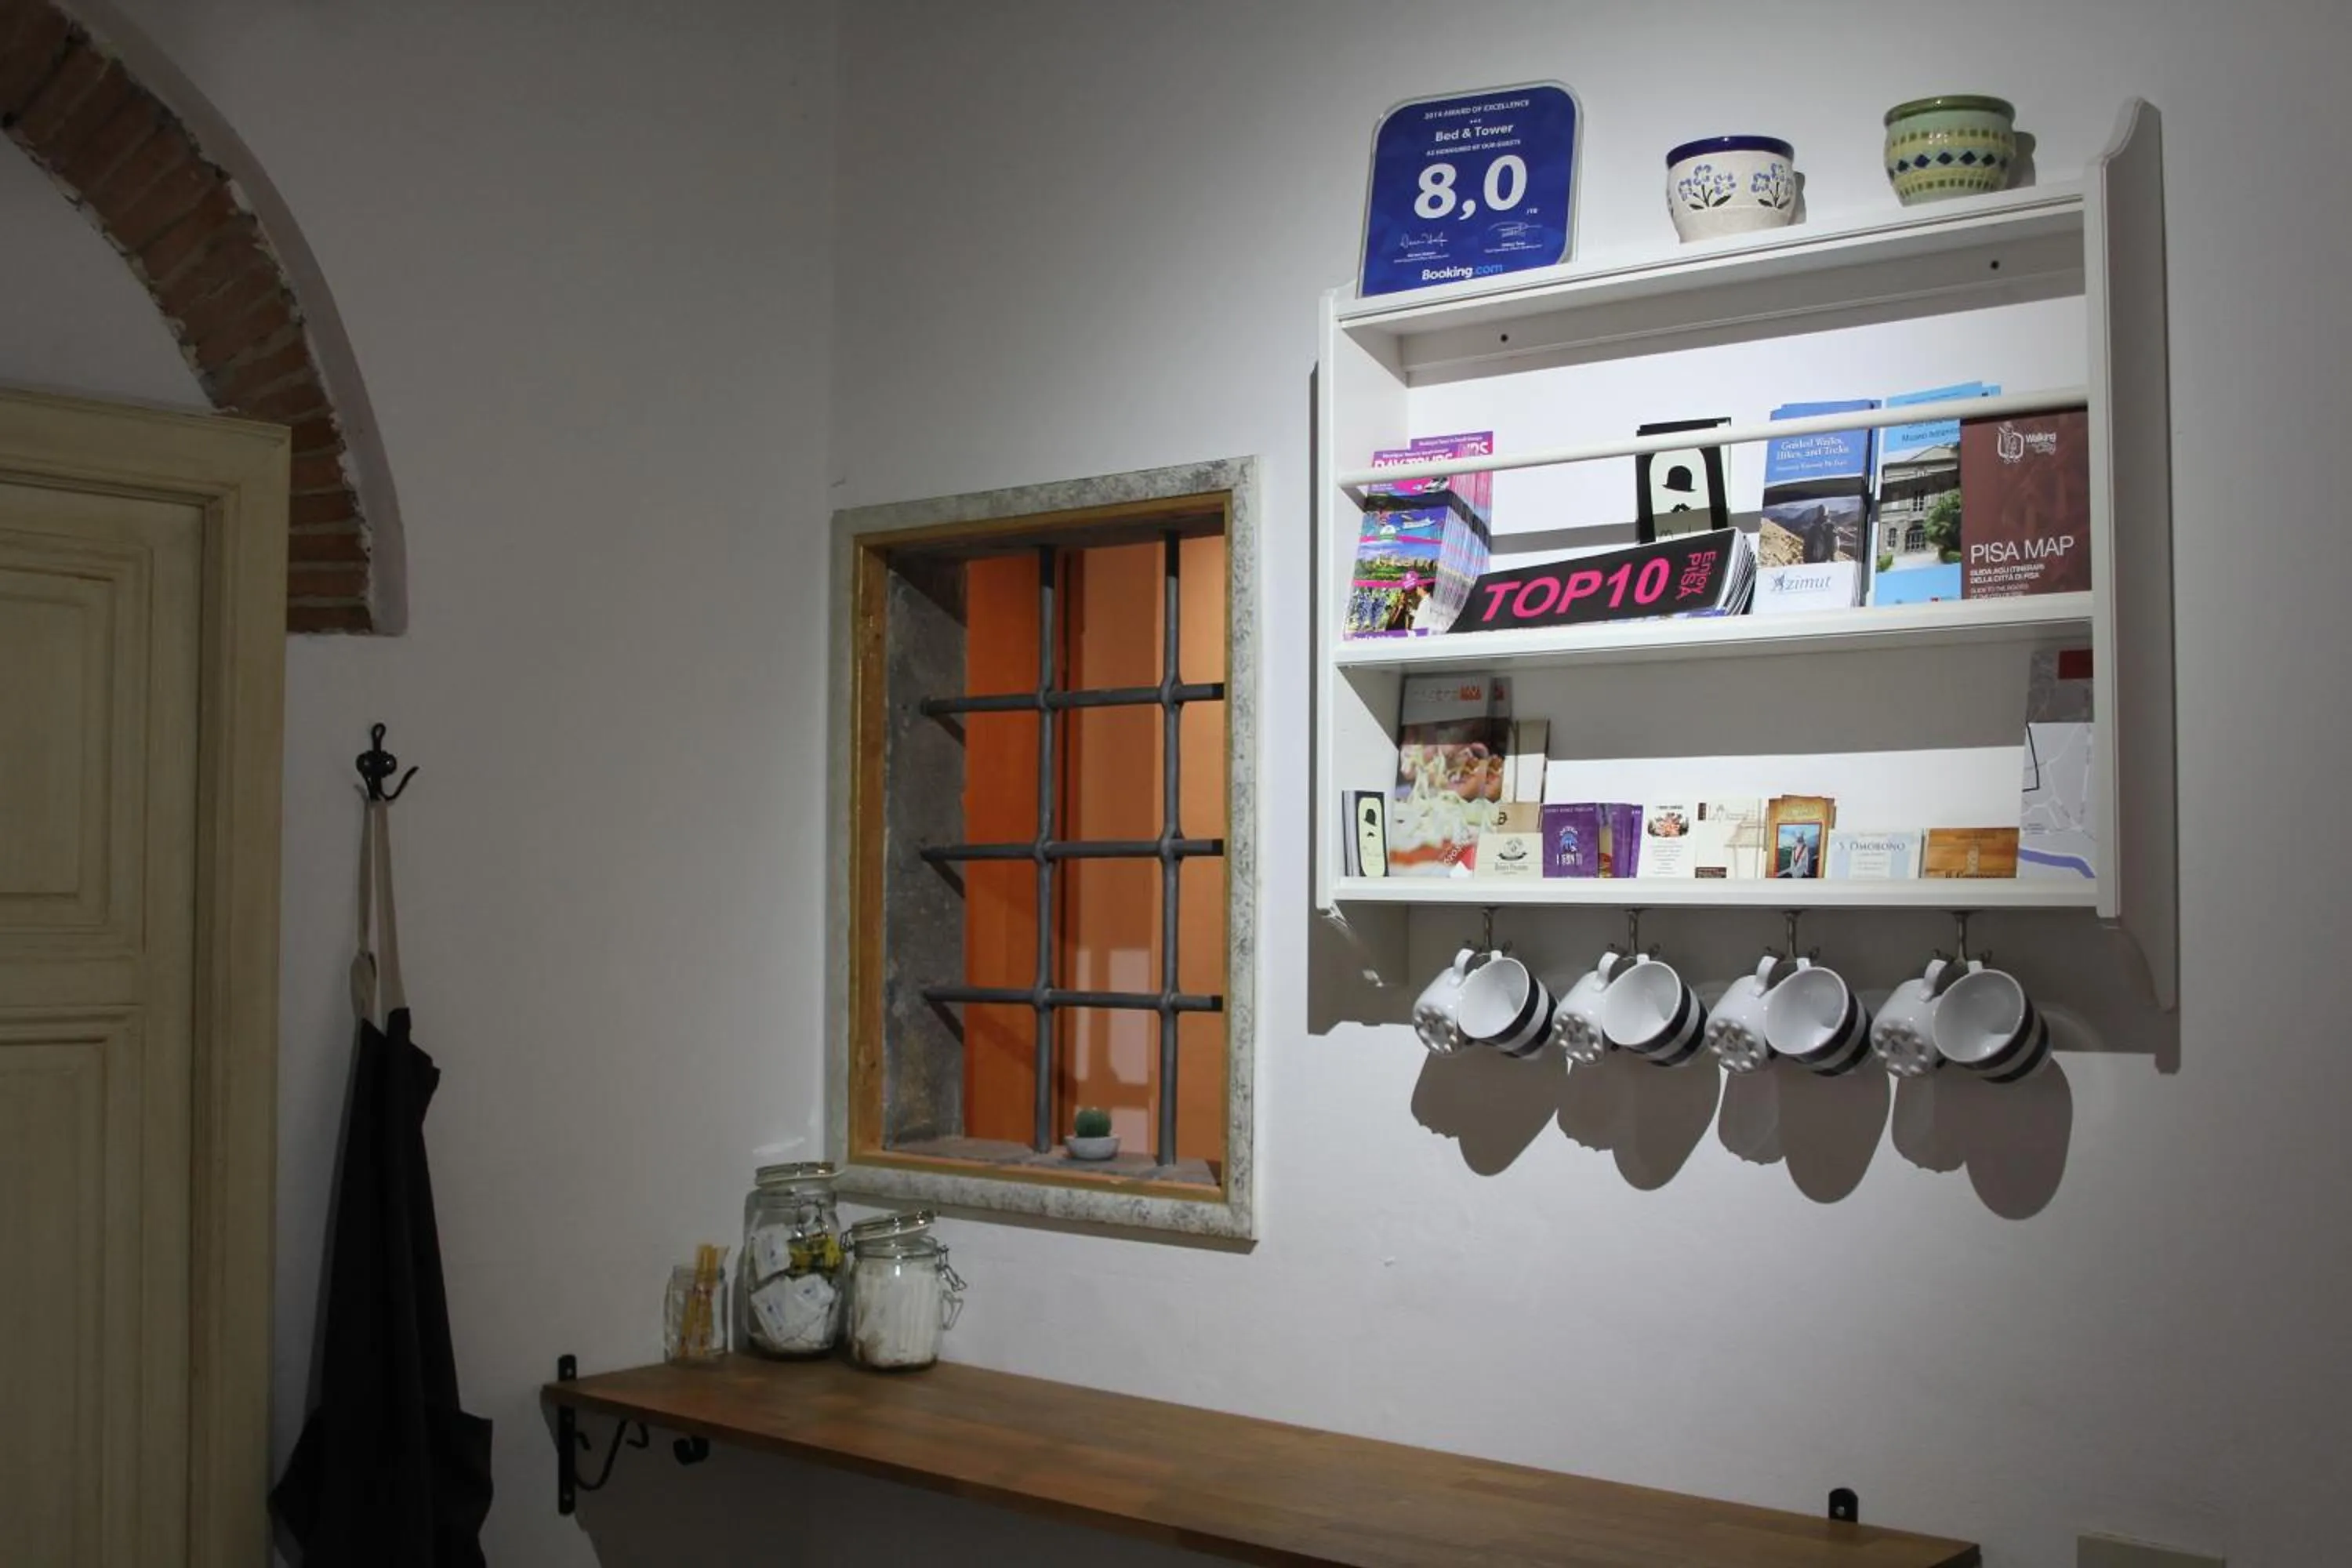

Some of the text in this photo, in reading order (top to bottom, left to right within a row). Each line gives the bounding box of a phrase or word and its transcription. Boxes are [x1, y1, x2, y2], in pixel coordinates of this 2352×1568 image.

[1472, 105, 1481, 114] OF
[1436, 125, 1514, 142] Bed & Tower
[1414, 154, 1527, 220] 8,0
[1970, 535, 2074, 564] PISA MAP
[1481, 556, 1671, 622] TOP10
